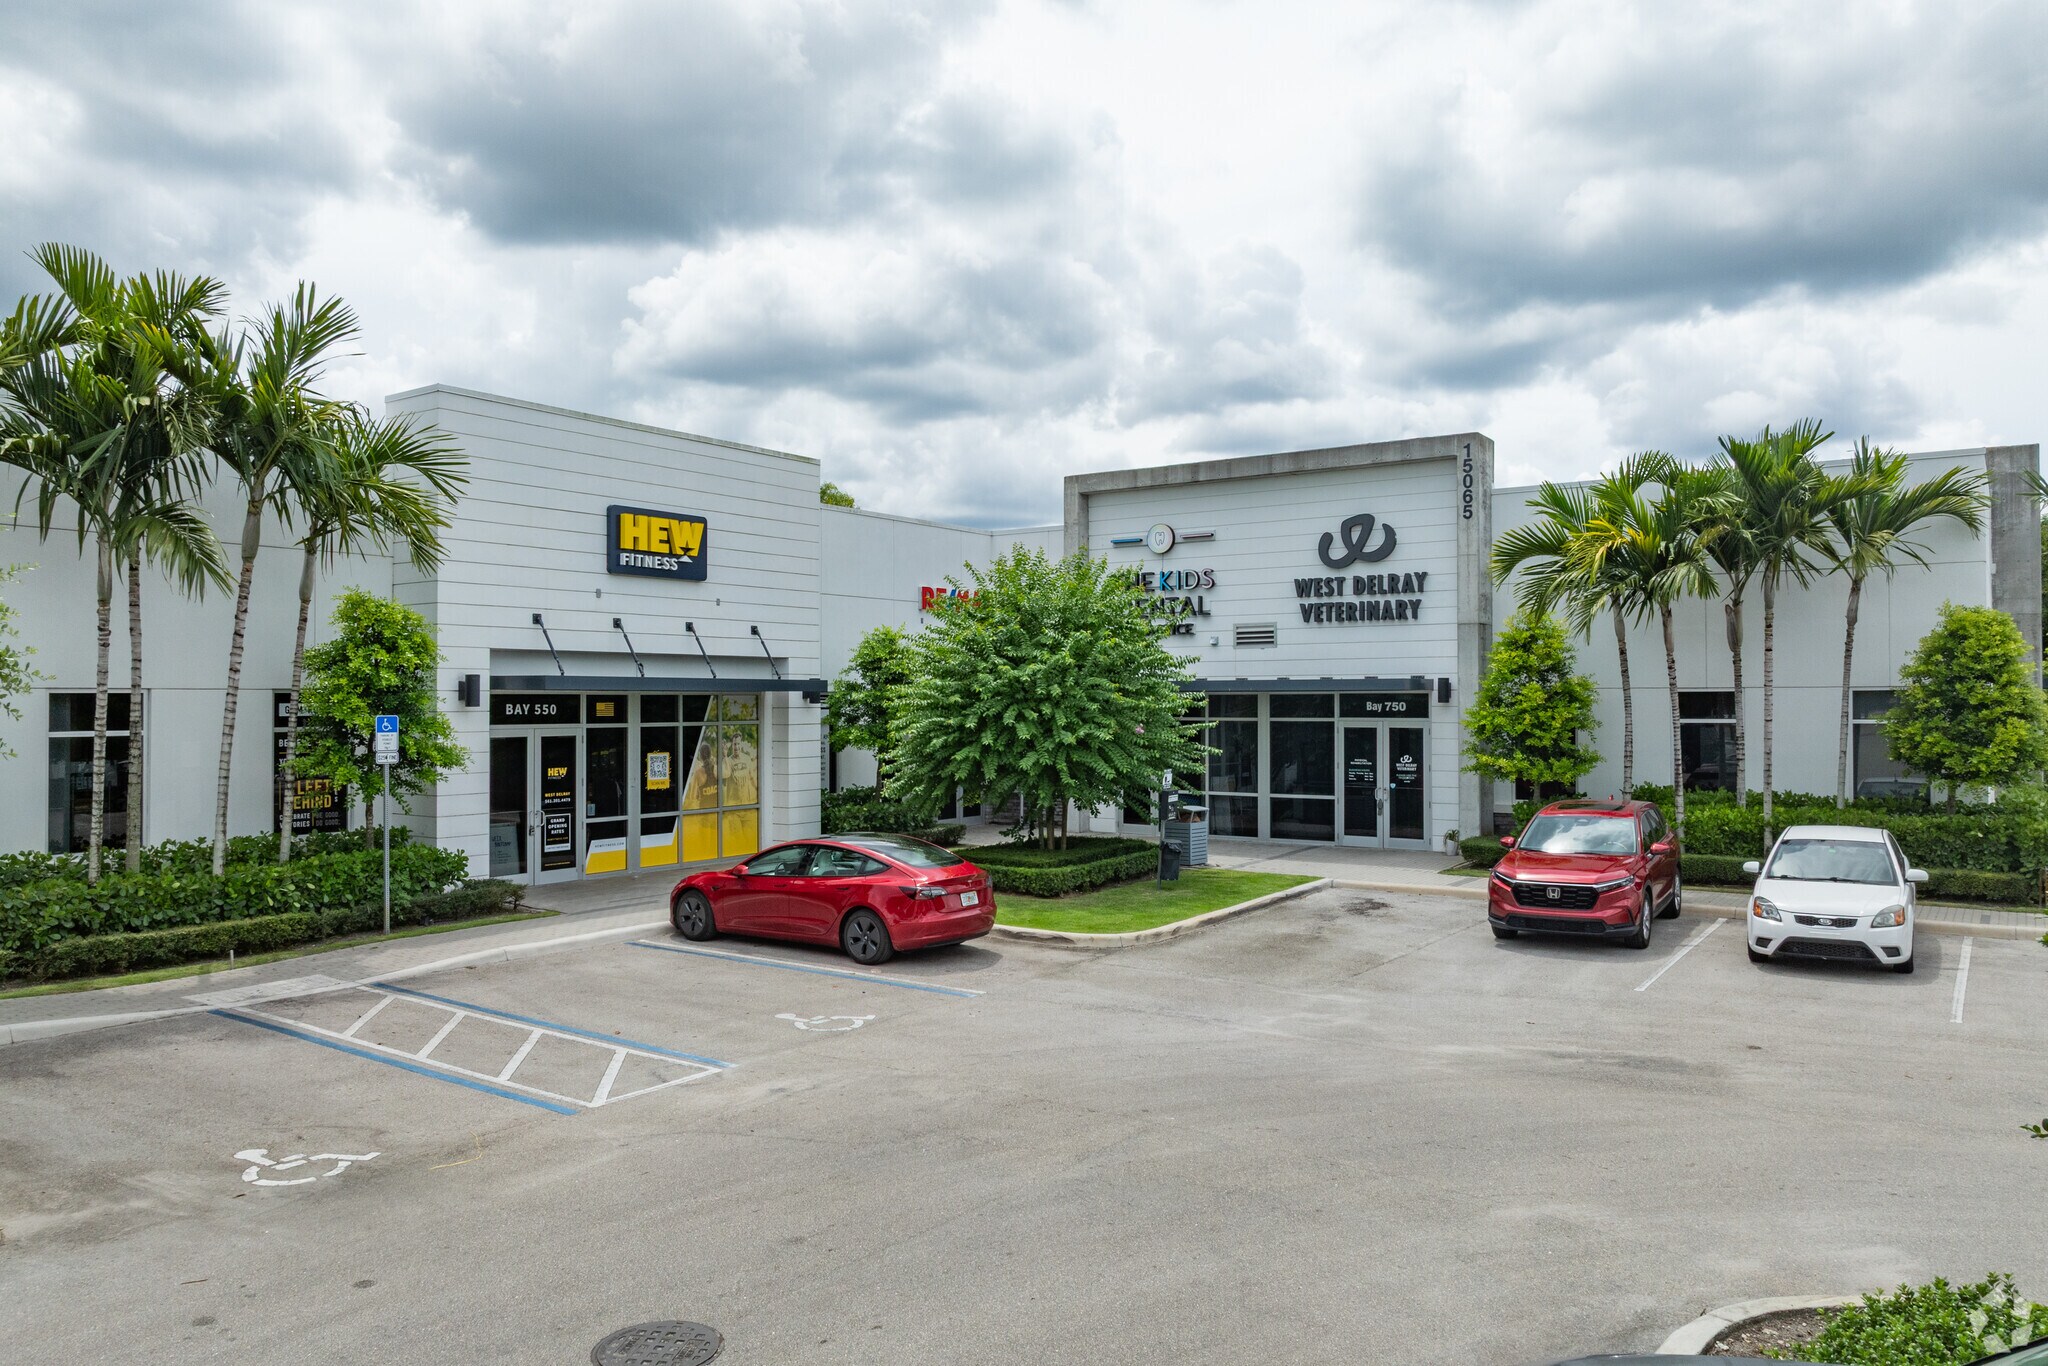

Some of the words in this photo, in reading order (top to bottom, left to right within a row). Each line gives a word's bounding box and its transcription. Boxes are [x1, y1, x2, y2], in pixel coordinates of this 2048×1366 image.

[1462, 443, 1474, 519] 15065
[619, 513, 705, 557] HEW
[619, 552, 679, 571] FITNESS
[1159, 567, 1216, 592] KIDS
[1293, 576, 1347, 598] WEST
[1352, 571, 1428, 596] DELRAY
[1300, 599, 1422, 623] VETERINARY
[505, 703, 530, 715] BAY
[534, 704, 557, 715] 550
[1366, 701, 1382, 712] Bay
[1384, 701, 1406, 711] 750
[547, 766, 568, 777] HEW
[293, 794, 332, 810] EHIND
